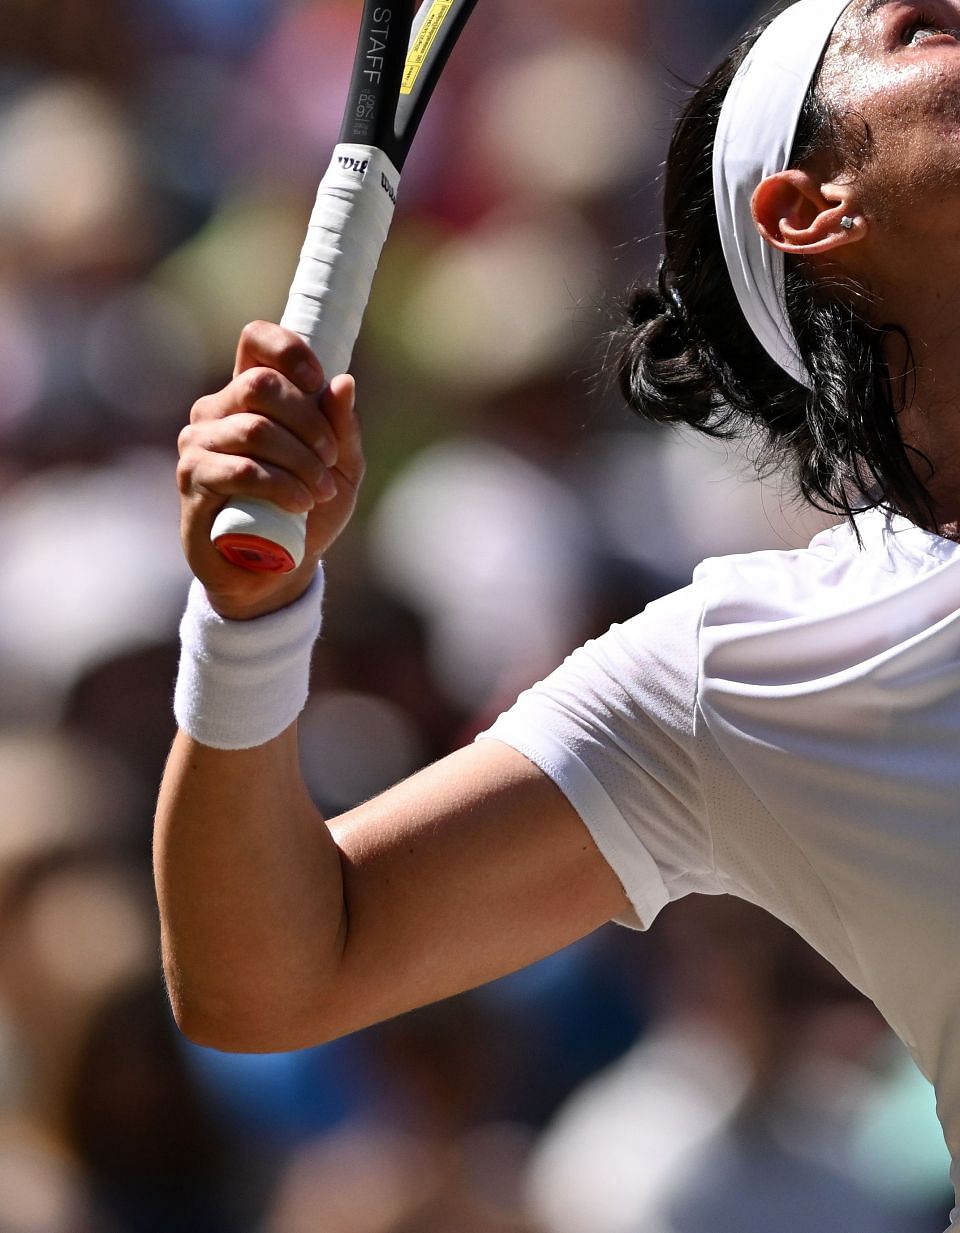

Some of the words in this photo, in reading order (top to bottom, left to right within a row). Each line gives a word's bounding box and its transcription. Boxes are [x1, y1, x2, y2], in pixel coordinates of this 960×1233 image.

[363, 7, 391, 84] STAFF
[358, 94, 376, 106] PS
[355, 105, 374, 119] 97
